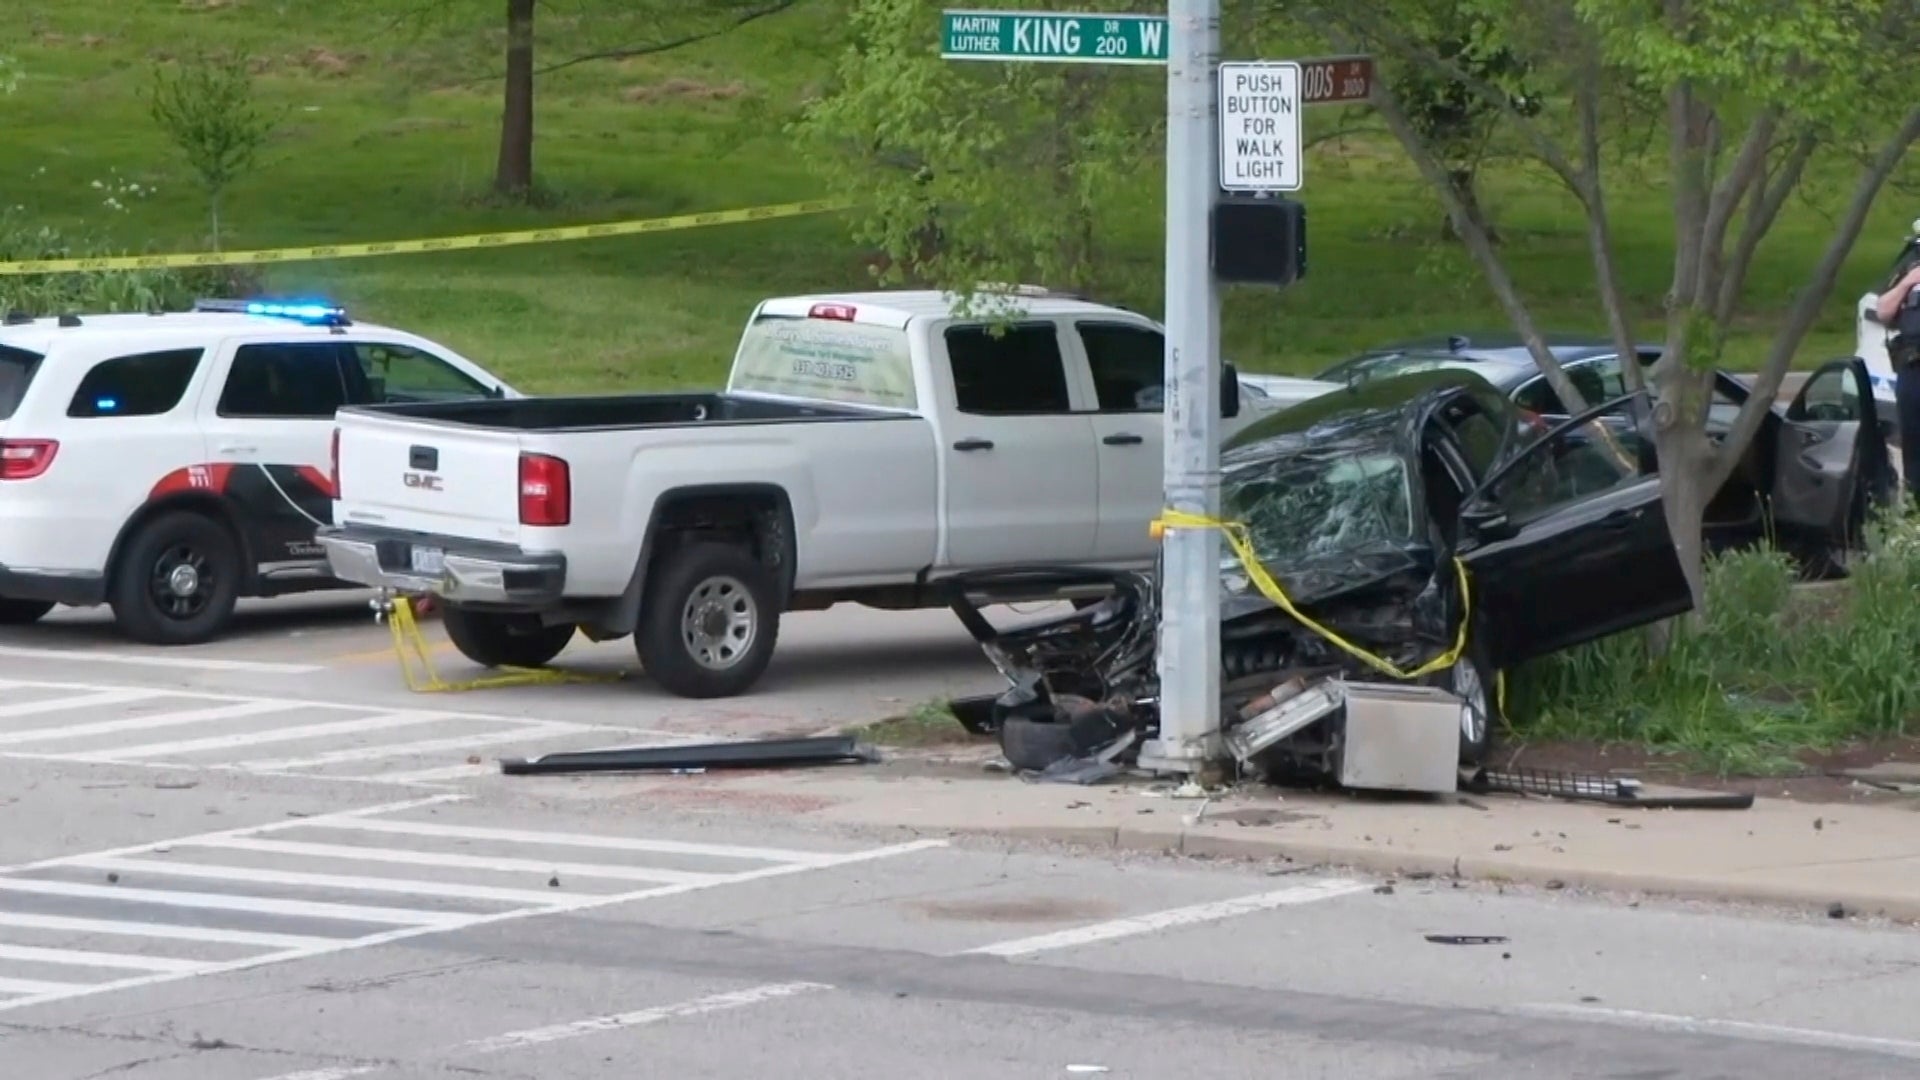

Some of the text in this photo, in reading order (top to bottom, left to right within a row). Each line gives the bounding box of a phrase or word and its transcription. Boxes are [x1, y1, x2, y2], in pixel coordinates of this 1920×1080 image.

[952, 17, 1000, 33] MARTIN
[951, 36, 1000, 51] LUTHER
[1013, 18, 1162, 56] KING DR W
[1096, 37, 1127, 55] 200
[1236, 74, 1282, 93] PUSH
[1227, 96, 1292, 114] BUTTON
[1243, 118, 1276, 135] FOR
[1237, 138, 1284, 157] WALK
[1236, 160, 1284, 178] LIGHT
[403, 472, 444, 492] GMC
